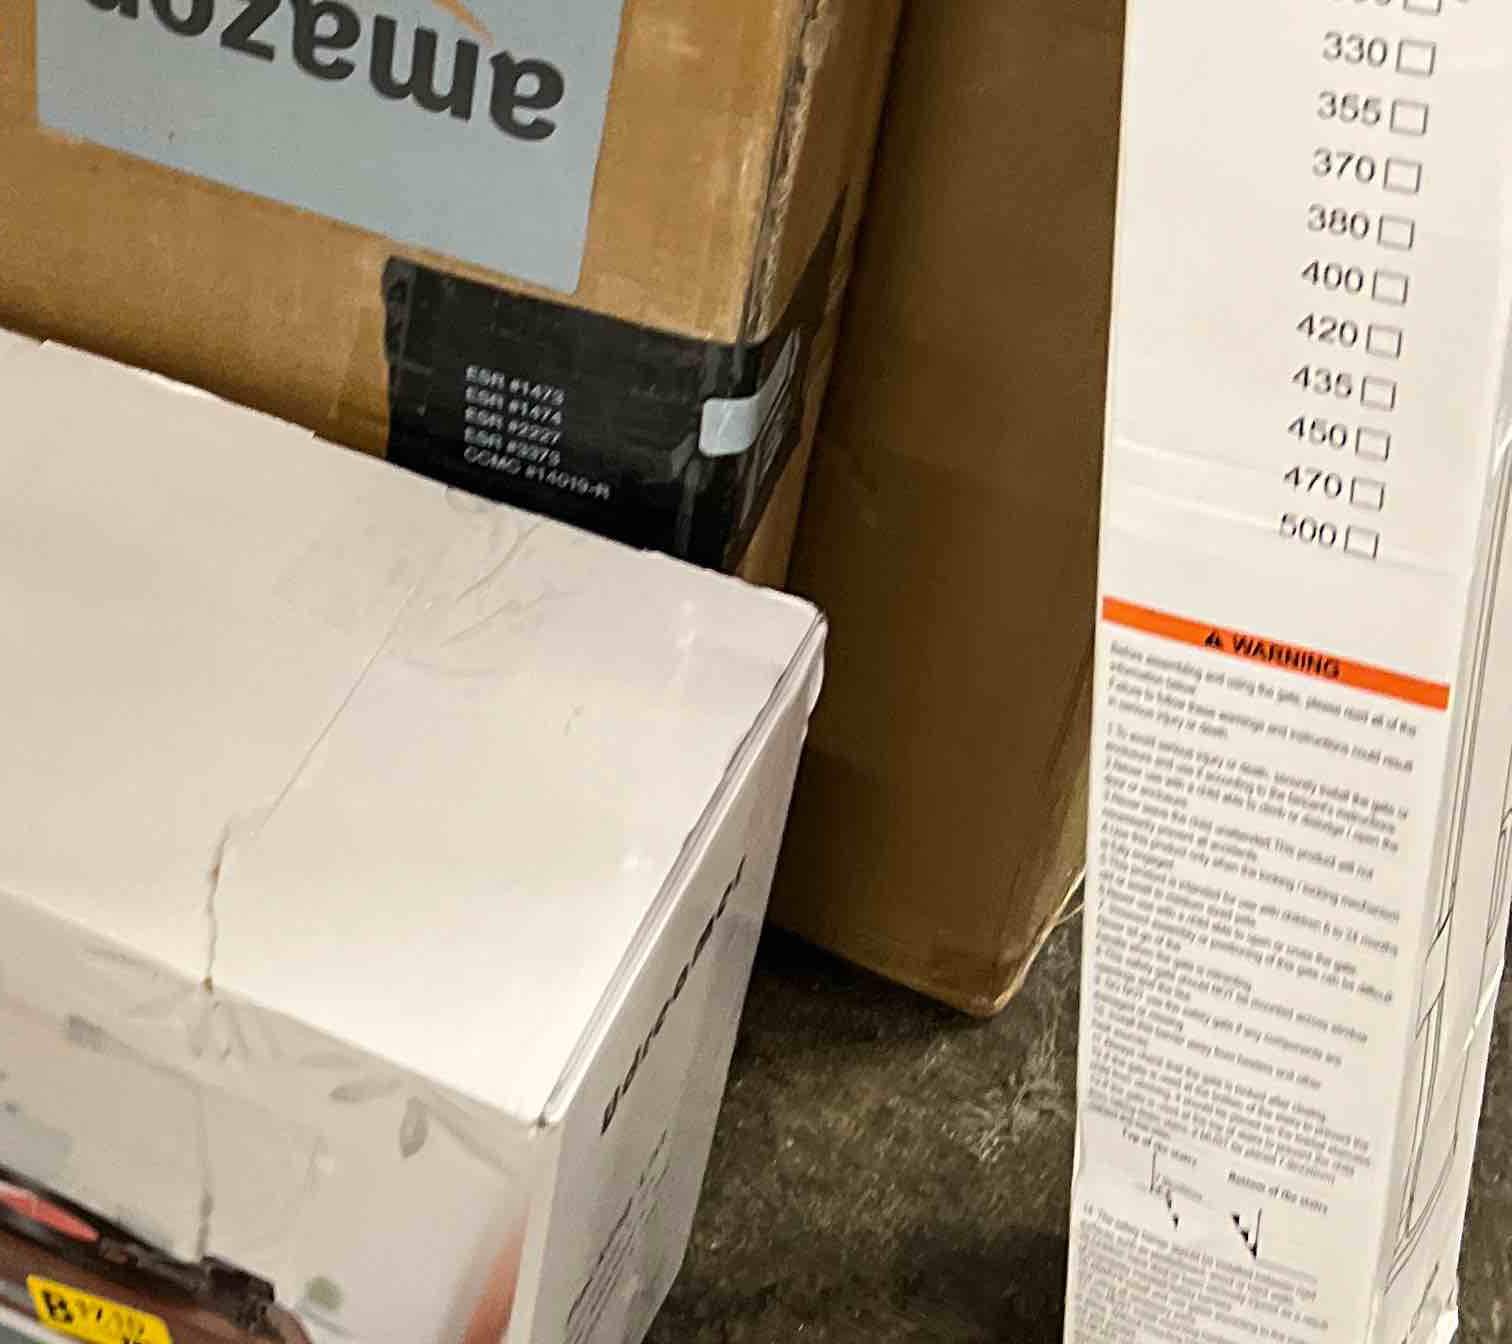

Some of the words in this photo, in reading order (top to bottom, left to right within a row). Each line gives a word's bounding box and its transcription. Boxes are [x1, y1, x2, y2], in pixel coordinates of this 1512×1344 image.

[1322, 32, 1387, 67] 330
[1316, 90, 1381, 125] 355
[1311, 147, 1375, 182] 370
[1306, 203, 1369, 238] 380
[1301, 259, 1363, 294] 400
[1296, 313, 1358, 347] 420
[1291, 364, 1352, 397] 435
[1287, 415, 1348, 451] 450
[1282, 465, 1342, 499] 470
[1279, 511, 1337, 548] 500
[1232, 634, 1340, 680] WARNING
